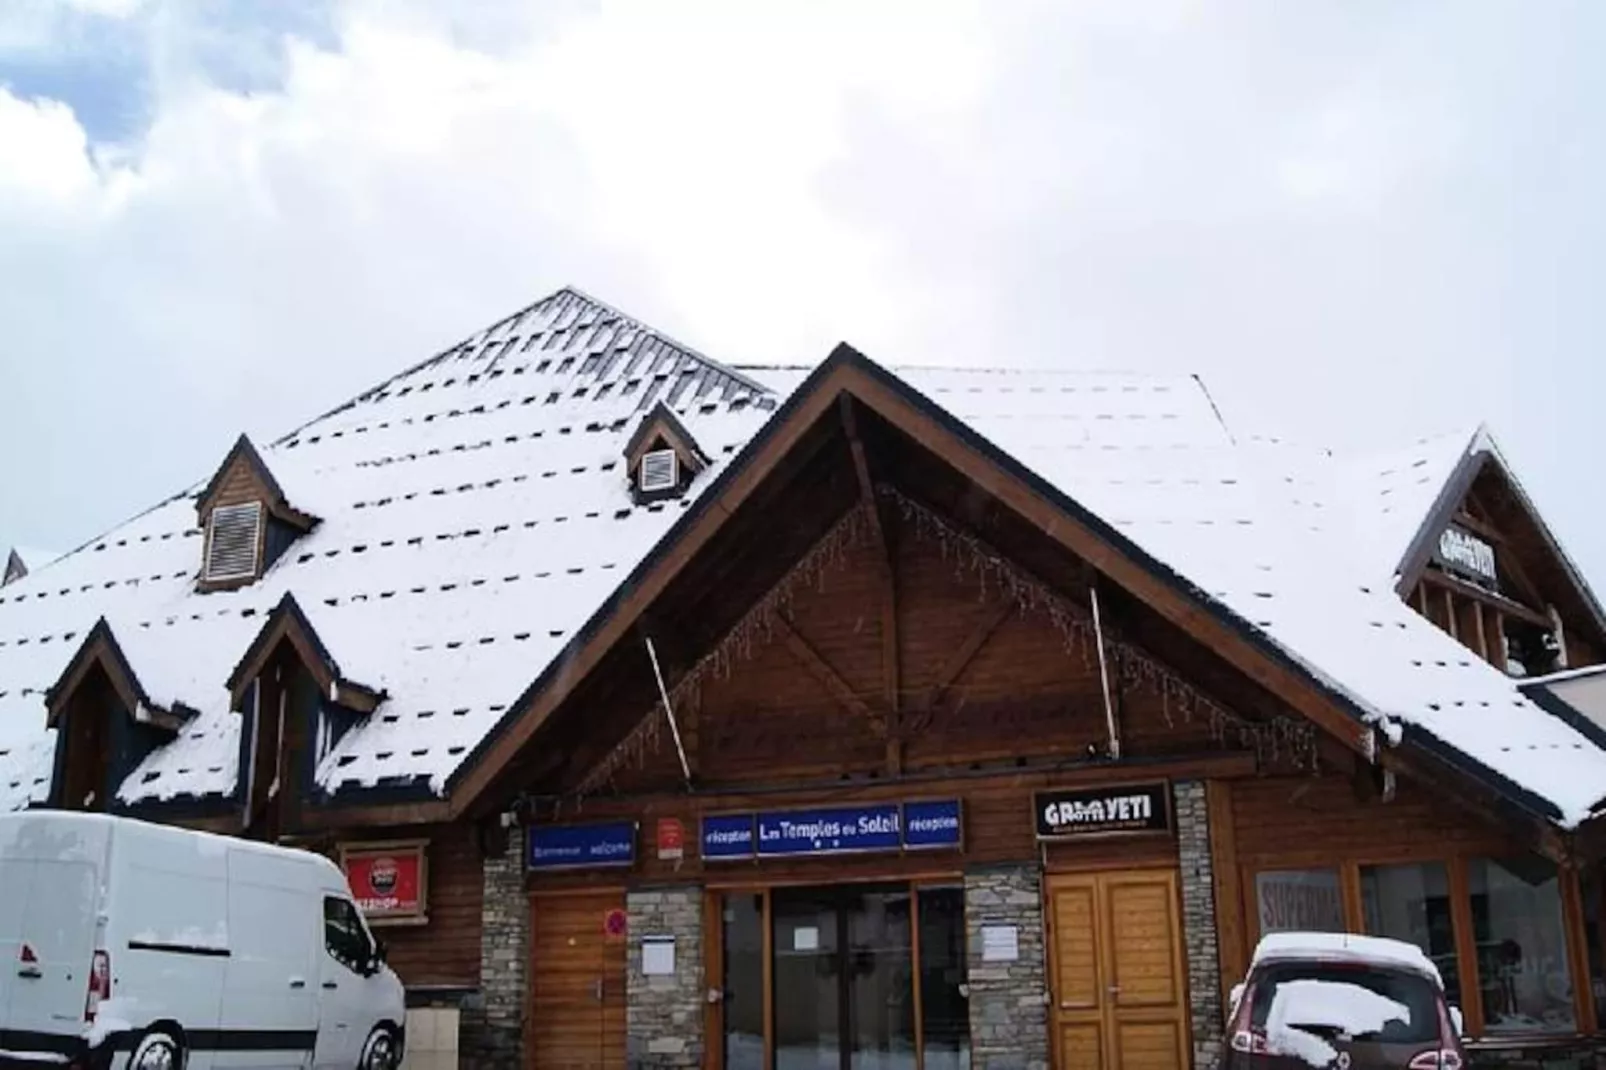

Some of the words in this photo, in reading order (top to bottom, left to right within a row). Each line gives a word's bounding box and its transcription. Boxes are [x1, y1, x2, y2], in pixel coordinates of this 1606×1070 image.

[1105, 794, 1151, 819] YETI
[780, 819, 840, 841] Temples
[858, 813, 900, 834] Soleil
